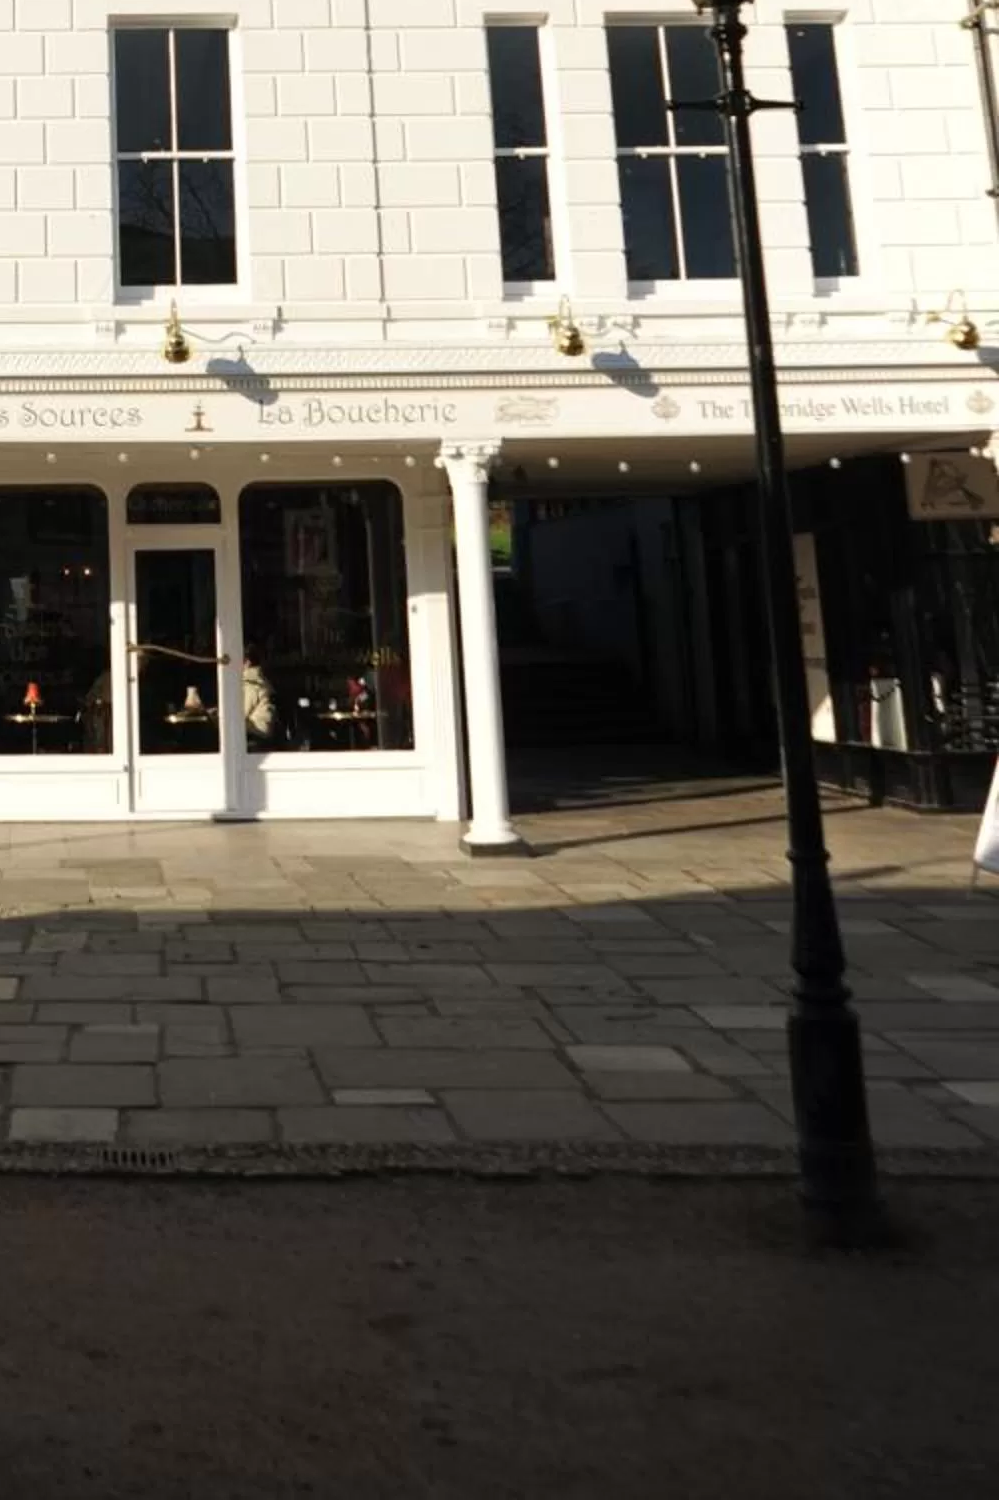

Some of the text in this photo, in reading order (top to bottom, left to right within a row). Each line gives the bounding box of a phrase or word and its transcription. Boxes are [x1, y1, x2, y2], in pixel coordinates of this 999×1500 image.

[19, 400, 144, 429] Sources
[257, 396, 458, 427] La Boucherie
[696, 399, 734, 419] The
[840, 396, 893, 418] Wells
[898, 395, 950, 416] Hotel
